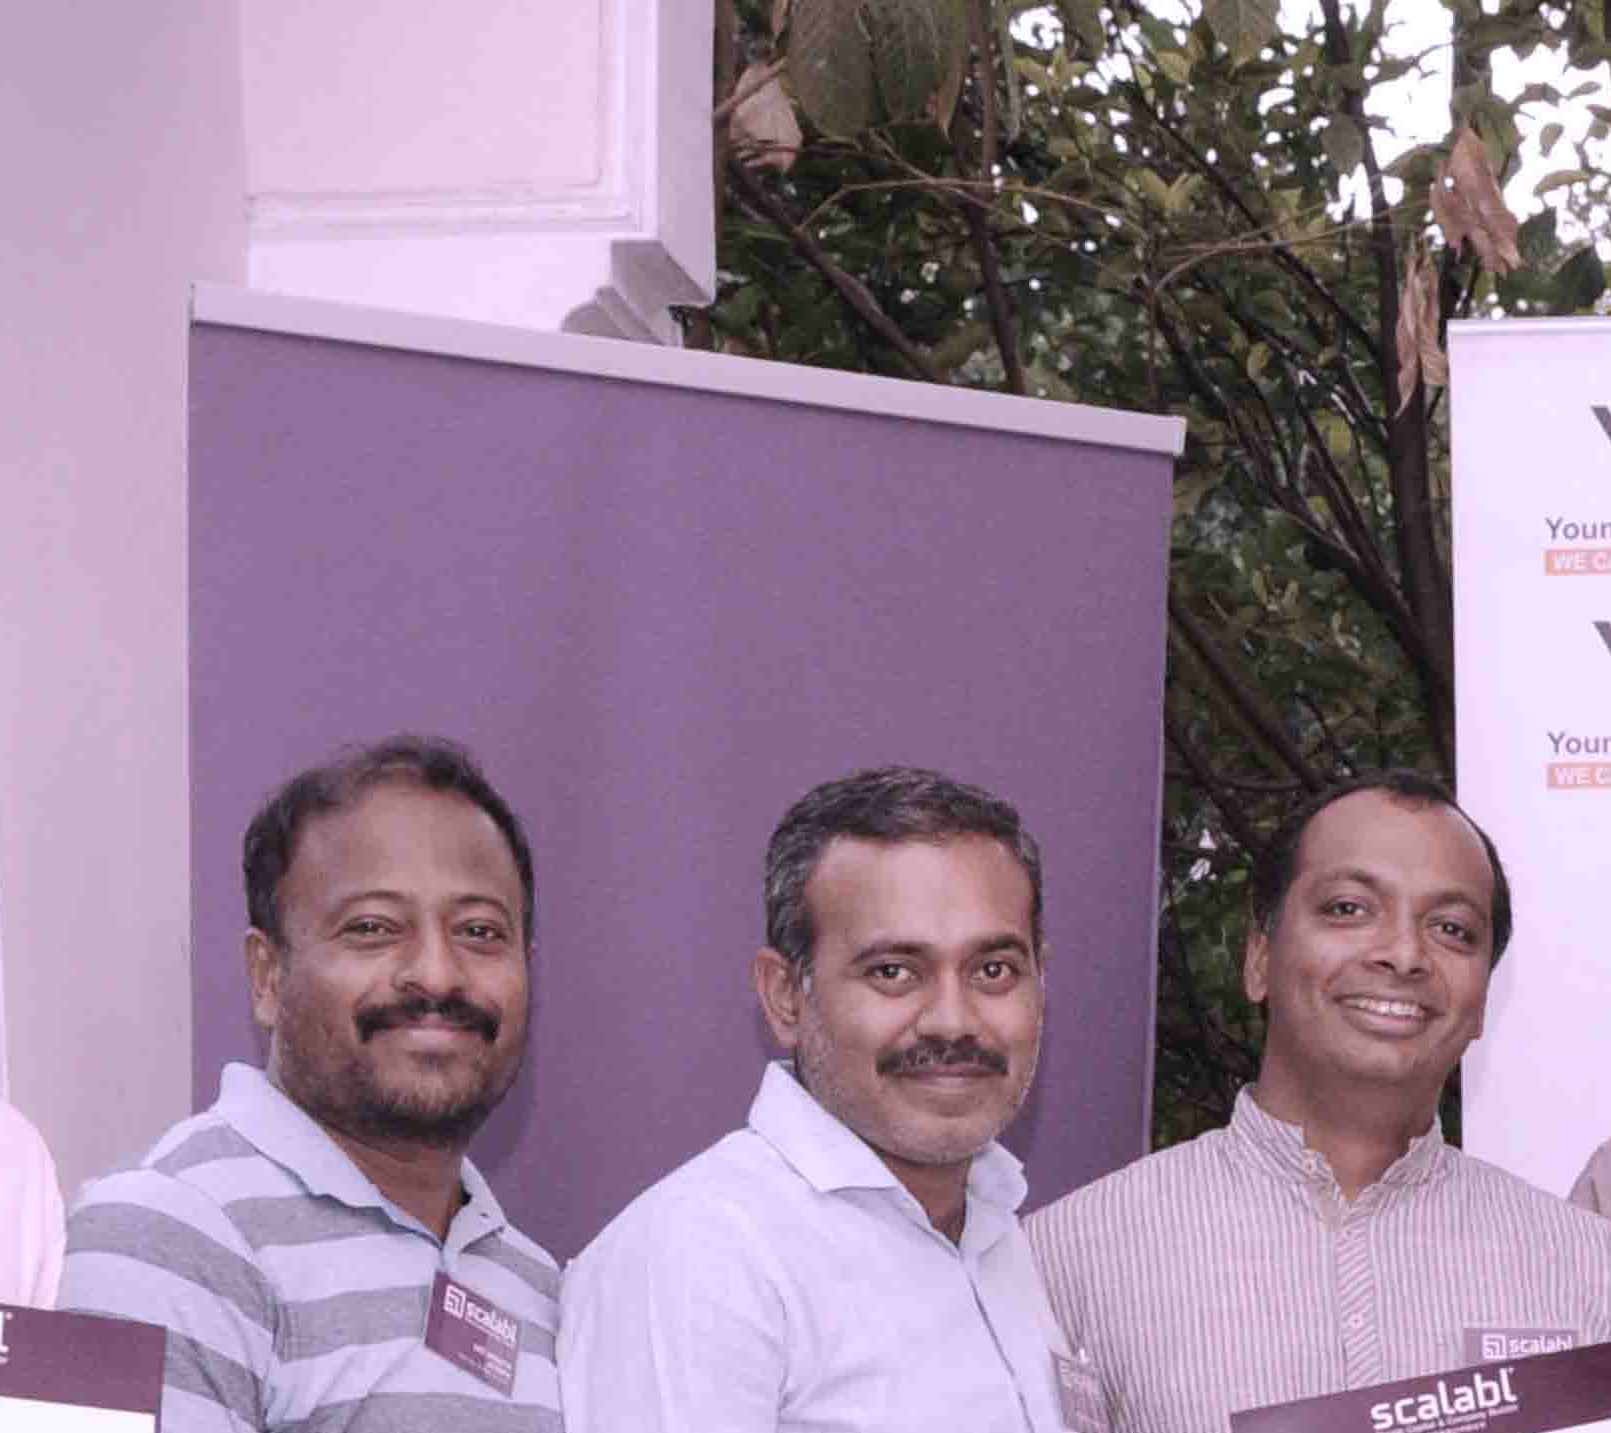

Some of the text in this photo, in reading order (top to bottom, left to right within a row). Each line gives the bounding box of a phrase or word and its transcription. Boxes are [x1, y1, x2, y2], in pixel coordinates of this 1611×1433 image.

[1554, 552, 1588, 570] WE
[1554, 767, 1590, 785] WE
[1372, 1367, 1518, 1430] scalabl
